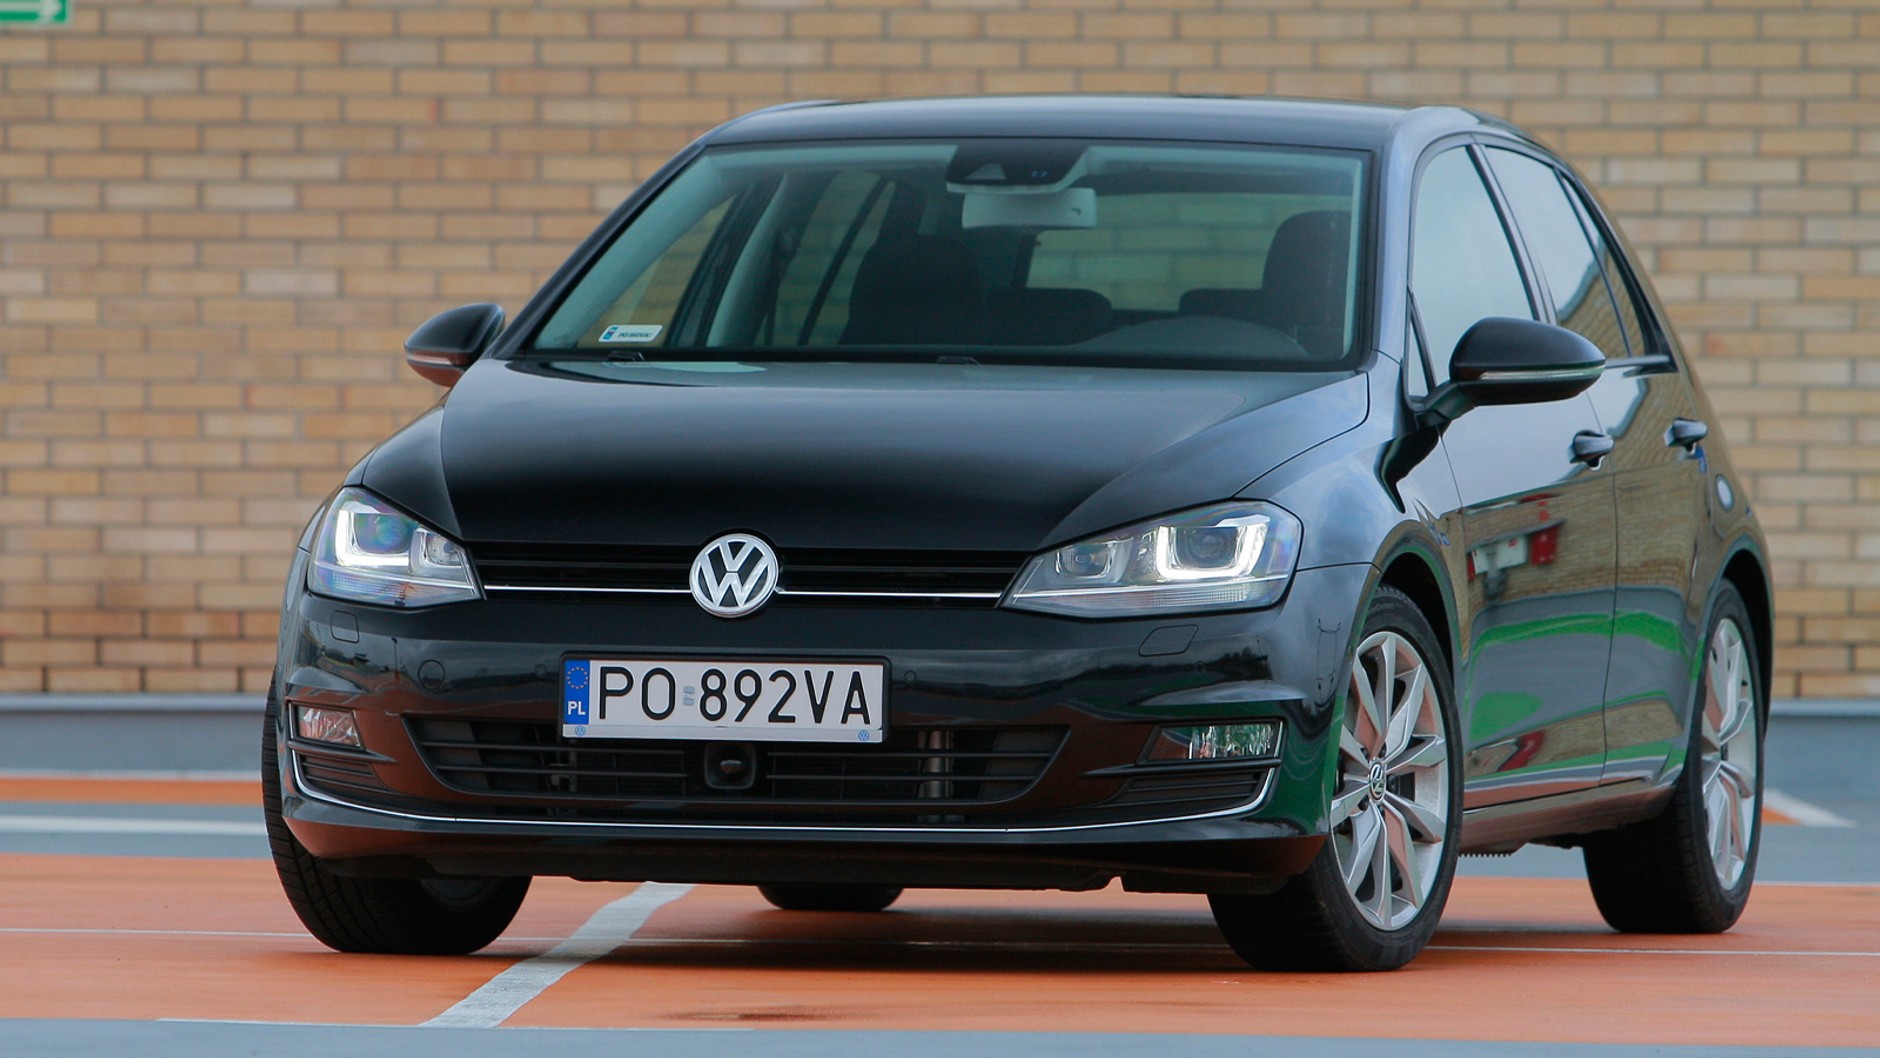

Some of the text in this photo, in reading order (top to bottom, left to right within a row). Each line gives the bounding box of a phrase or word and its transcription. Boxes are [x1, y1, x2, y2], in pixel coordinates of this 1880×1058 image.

[695, 536, 772, 609] VW
[567, 701, 586, 716] PL
[599, 666, 871, 725] PO 892VA
